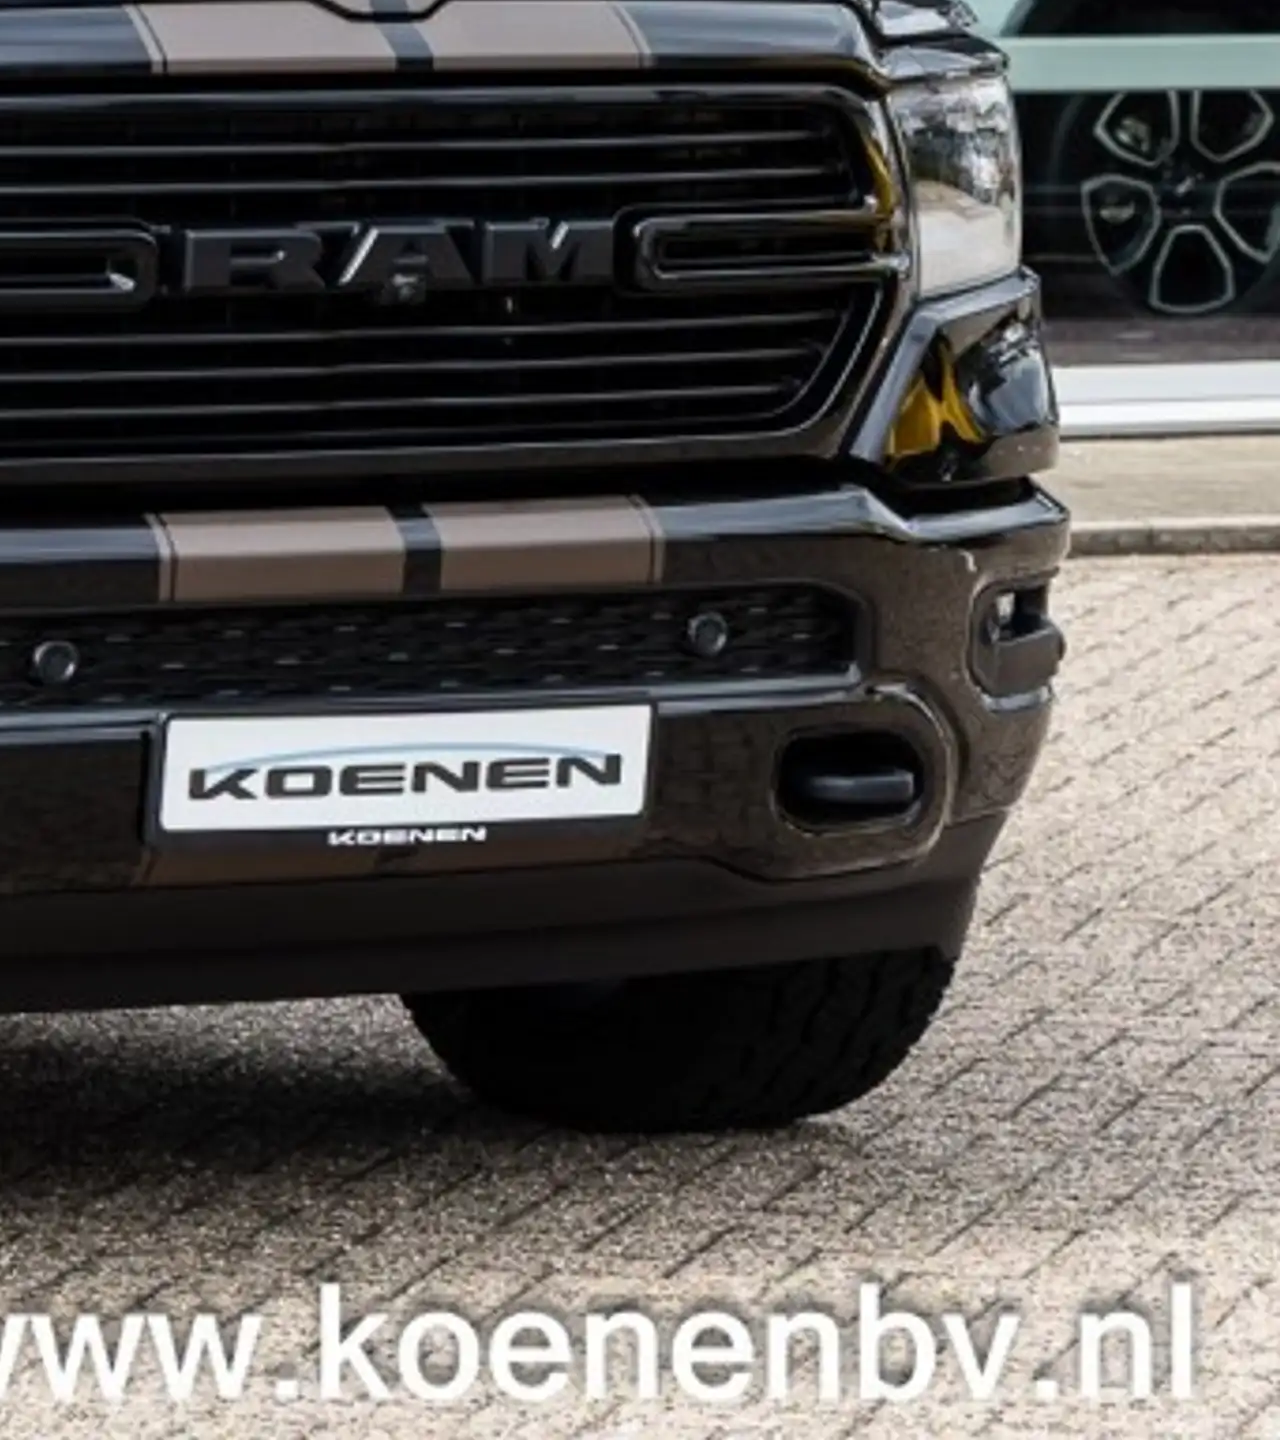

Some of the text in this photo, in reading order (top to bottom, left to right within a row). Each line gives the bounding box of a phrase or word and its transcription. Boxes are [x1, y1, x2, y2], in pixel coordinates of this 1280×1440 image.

[183, 218, 614, 291] RAM
[188, 754, 622, 801] KOENEN
[327, 826, 487, 846] KOENEN
